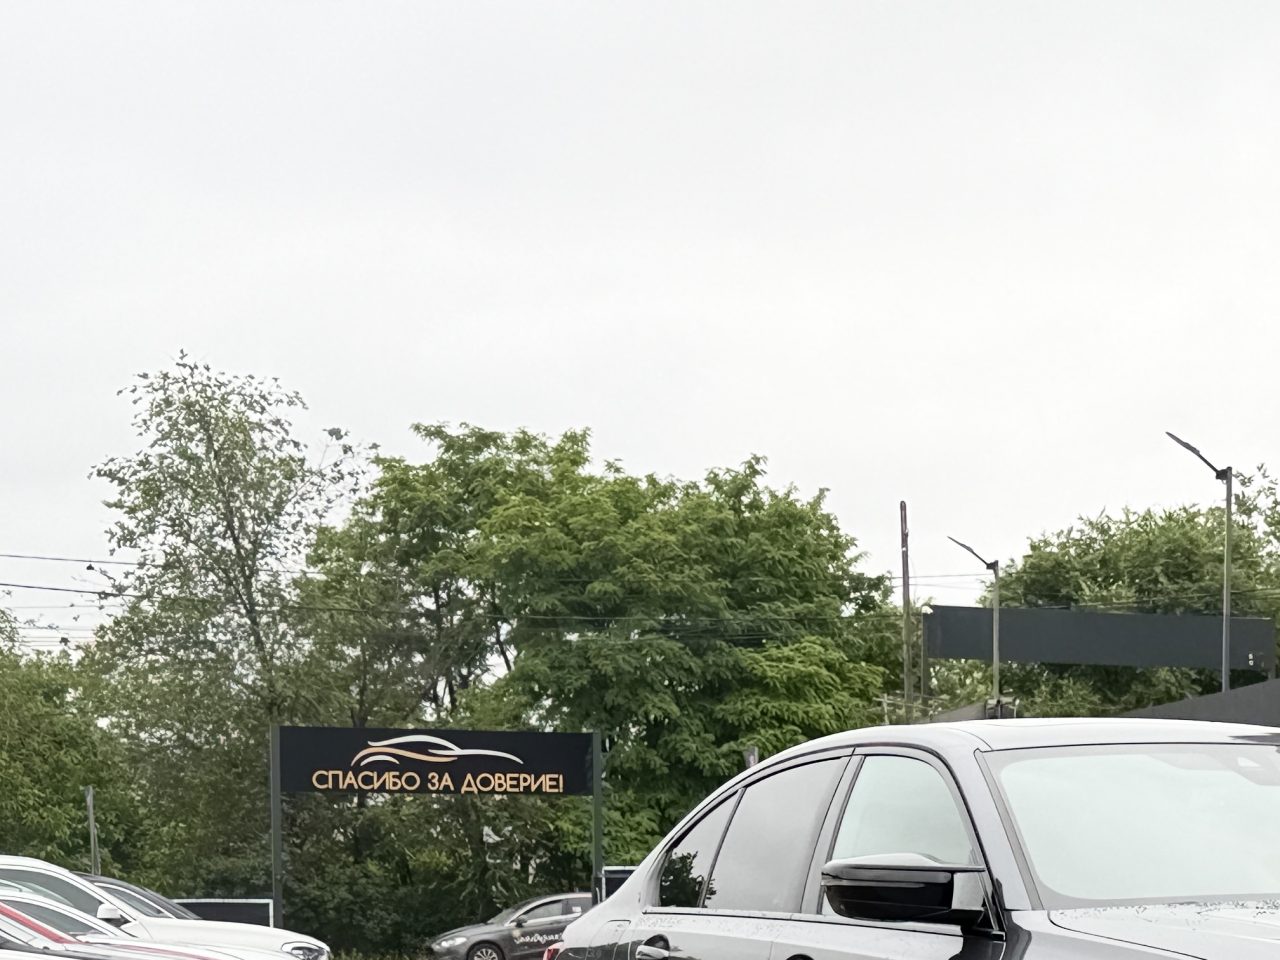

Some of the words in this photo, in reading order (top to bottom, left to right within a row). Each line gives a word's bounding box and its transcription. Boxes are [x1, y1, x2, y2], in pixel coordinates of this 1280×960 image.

[311, 769, 421, 791] СПАСИБО
[427, 771, 455, 791] ЗА
[460, 772, 563, 795] ДОВЕРИЕ!
